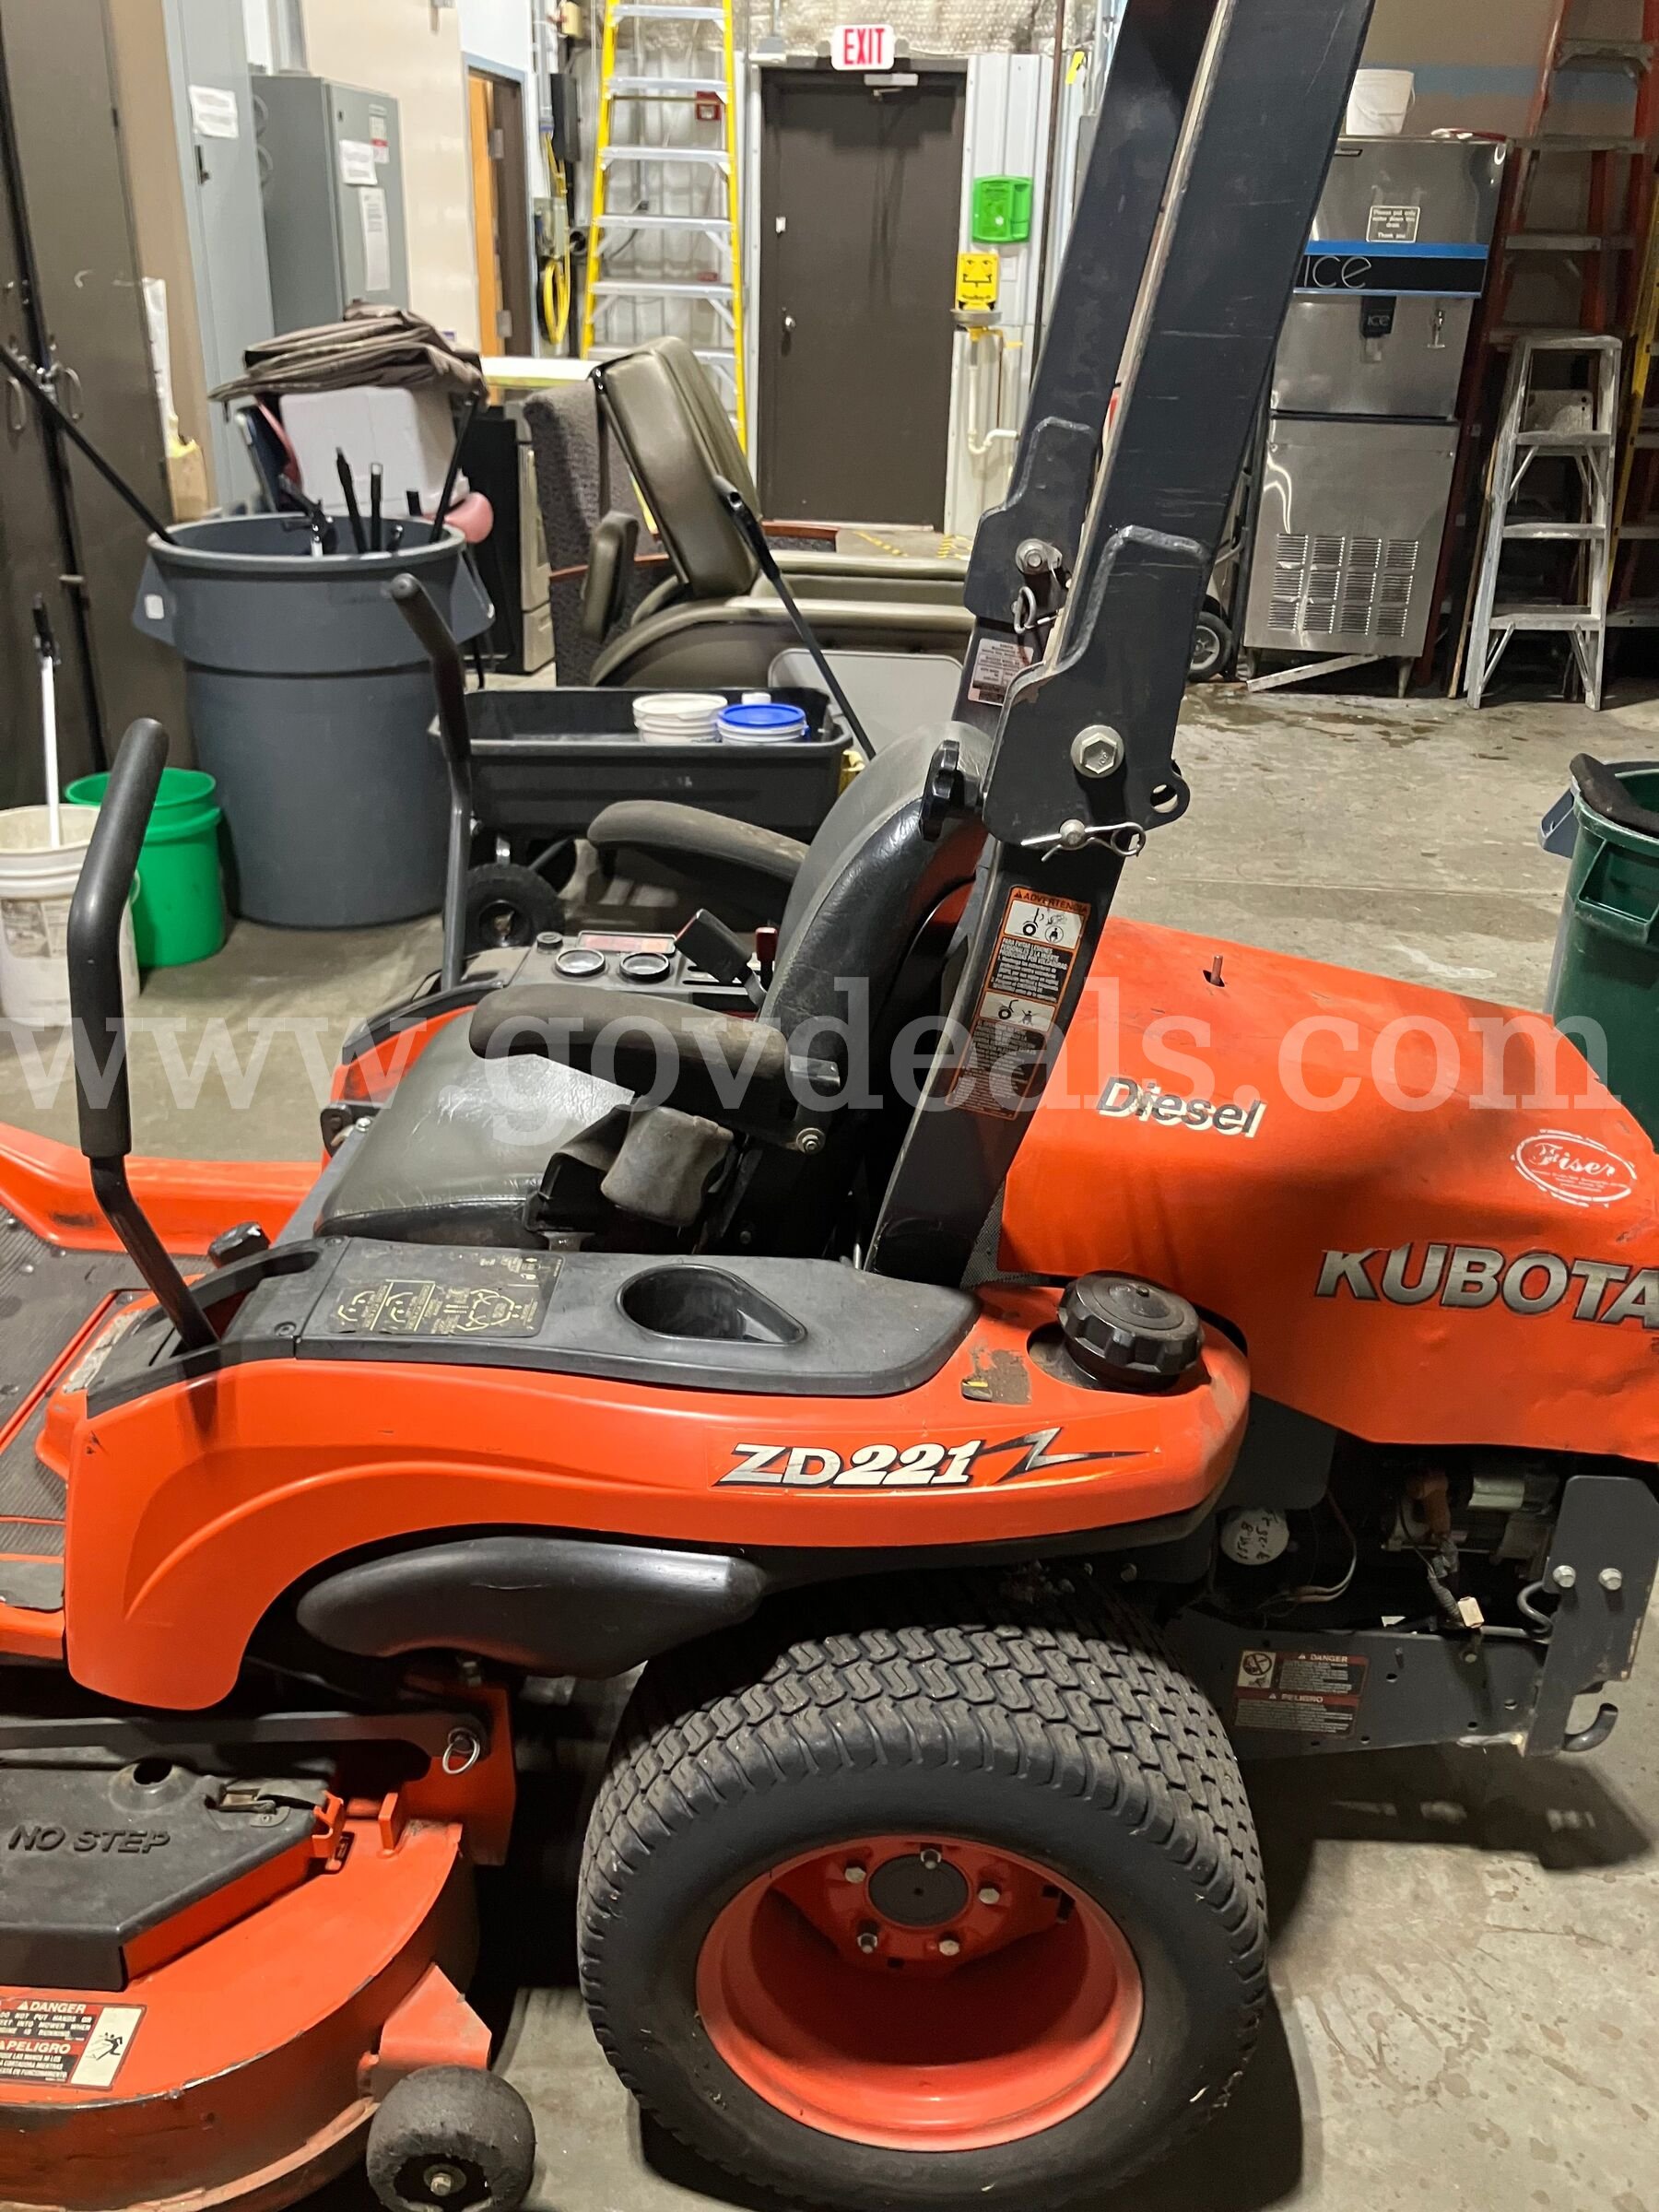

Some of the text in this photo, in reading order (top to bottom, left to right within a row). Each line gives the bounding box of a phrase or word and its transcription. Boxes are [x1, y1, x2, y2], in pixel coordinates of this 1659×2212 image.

[844, 28, 885, 65] EXIT
[1096, 1076, 1267, 1138] Diesel
[1314, 1242, 1659, 1331] KUBOTA
[711, 1439, 985, 1488] ZD221
[1311, 1653, 1348, 1663] DANGER
[7, 1824, 171, 1854] NO STEP
[15, 2011, 29, 2020] NOT
[33, 2013, 48, 2021] PUT
[29, 2000, 87, 2013] DANGER
[6, 2041, 71, 2054] PELIGRO
